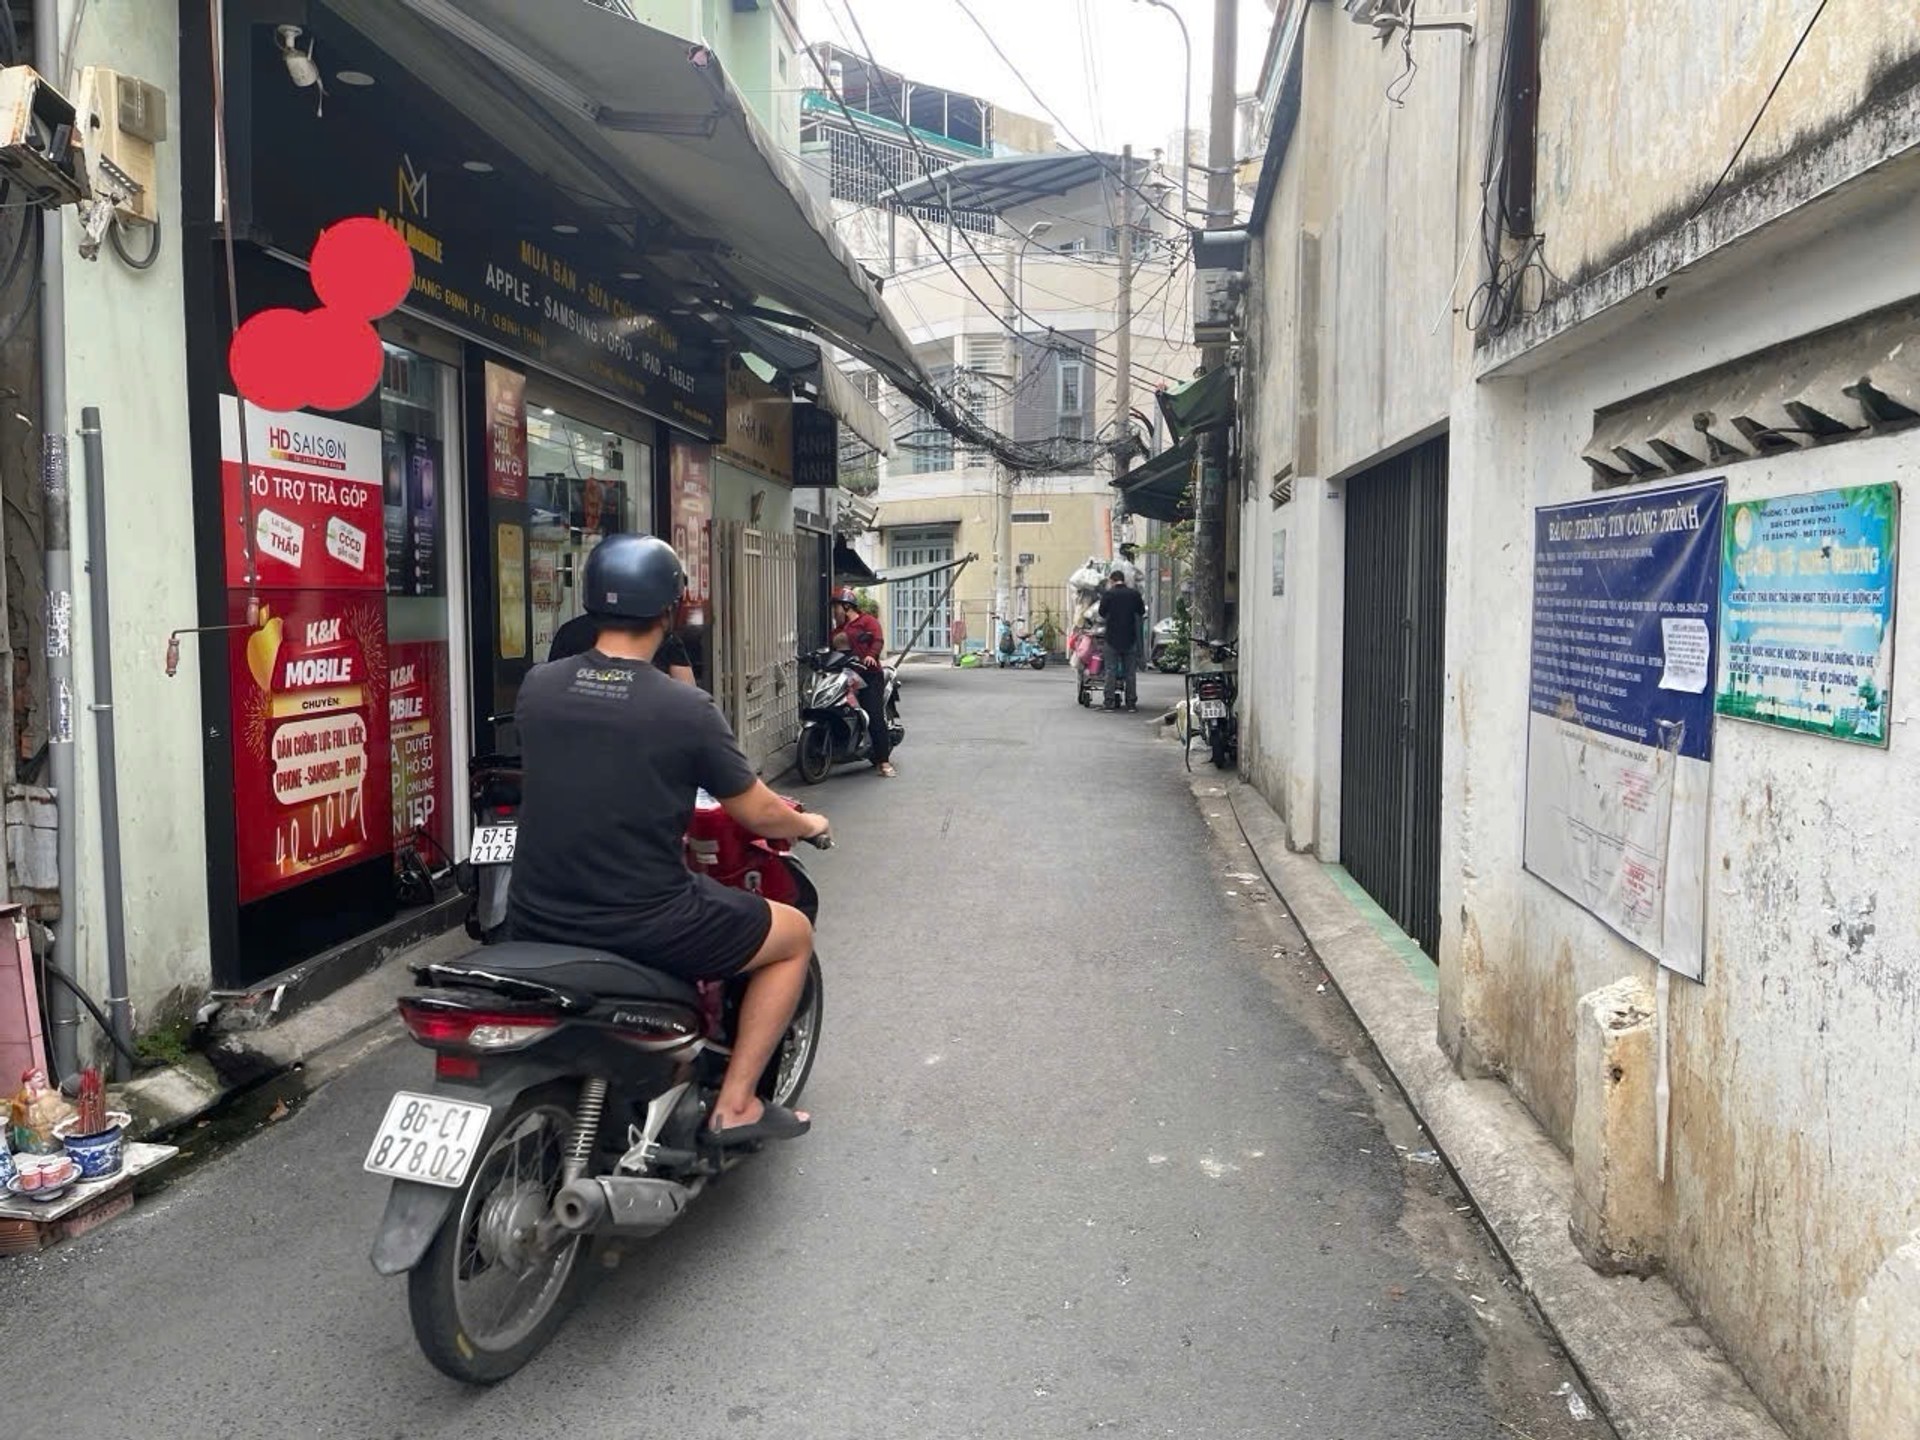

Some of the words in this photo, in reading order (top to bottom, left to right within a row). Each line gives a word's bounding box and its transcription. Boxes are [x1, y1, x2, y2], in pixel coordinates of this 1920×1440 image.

[521, 240, 548, 278] MUA
[553, 259, 577, 292] BÁN
[411, 273, 443, 300] UANG
[485, 263, 531, 308] APPLE
[544, 295, 599, 343] SAMSUNG
[607, 331, 633, 362] OPPO
[641, 351, 662, 376] IPAD
[668, 365, 695, 395] TABLET
[270, 426, 291, 450] HD
[293, 431, 348, 461] SAISON
[273, 477, 305, 506] TRỢ
[309, 480, 338, 506] TRẢ
[340, 484, 368, 508] GÓP
[1549, 514, 1573, 541] BẢNG
[1574, 513, 1606, 540] THÔNG
[1608, 513, 1626, 537] TIN
[1627, 507, 1658, 536] CÔNG
[1659, 499, 1700, 533] TRÌNH
[271, 532, 300, 557] THẤP
[338, 532, 362, 553] CCCD
[306, 618, 342, 647] K&K
[285, 658, 353, 689] MOBILE
[389, 663, 416, 690] K&K
[389, 697, 423, 721] OBILE
[332, 728, 348, 750] FULL
[405, 733, 433, 755] DUYỆT
[276, 768, 302, 794] IPHONE
[345, 755, 361, 777] OPPO
[406, 776, 435, 796] ONLINE
[407, 795, 435, 828] 15P
[482, 827, 518, 844] 67-E
[399, 1100, 472, 1143] 86-C1
[373, 1134, 467, 1182] 878.02
